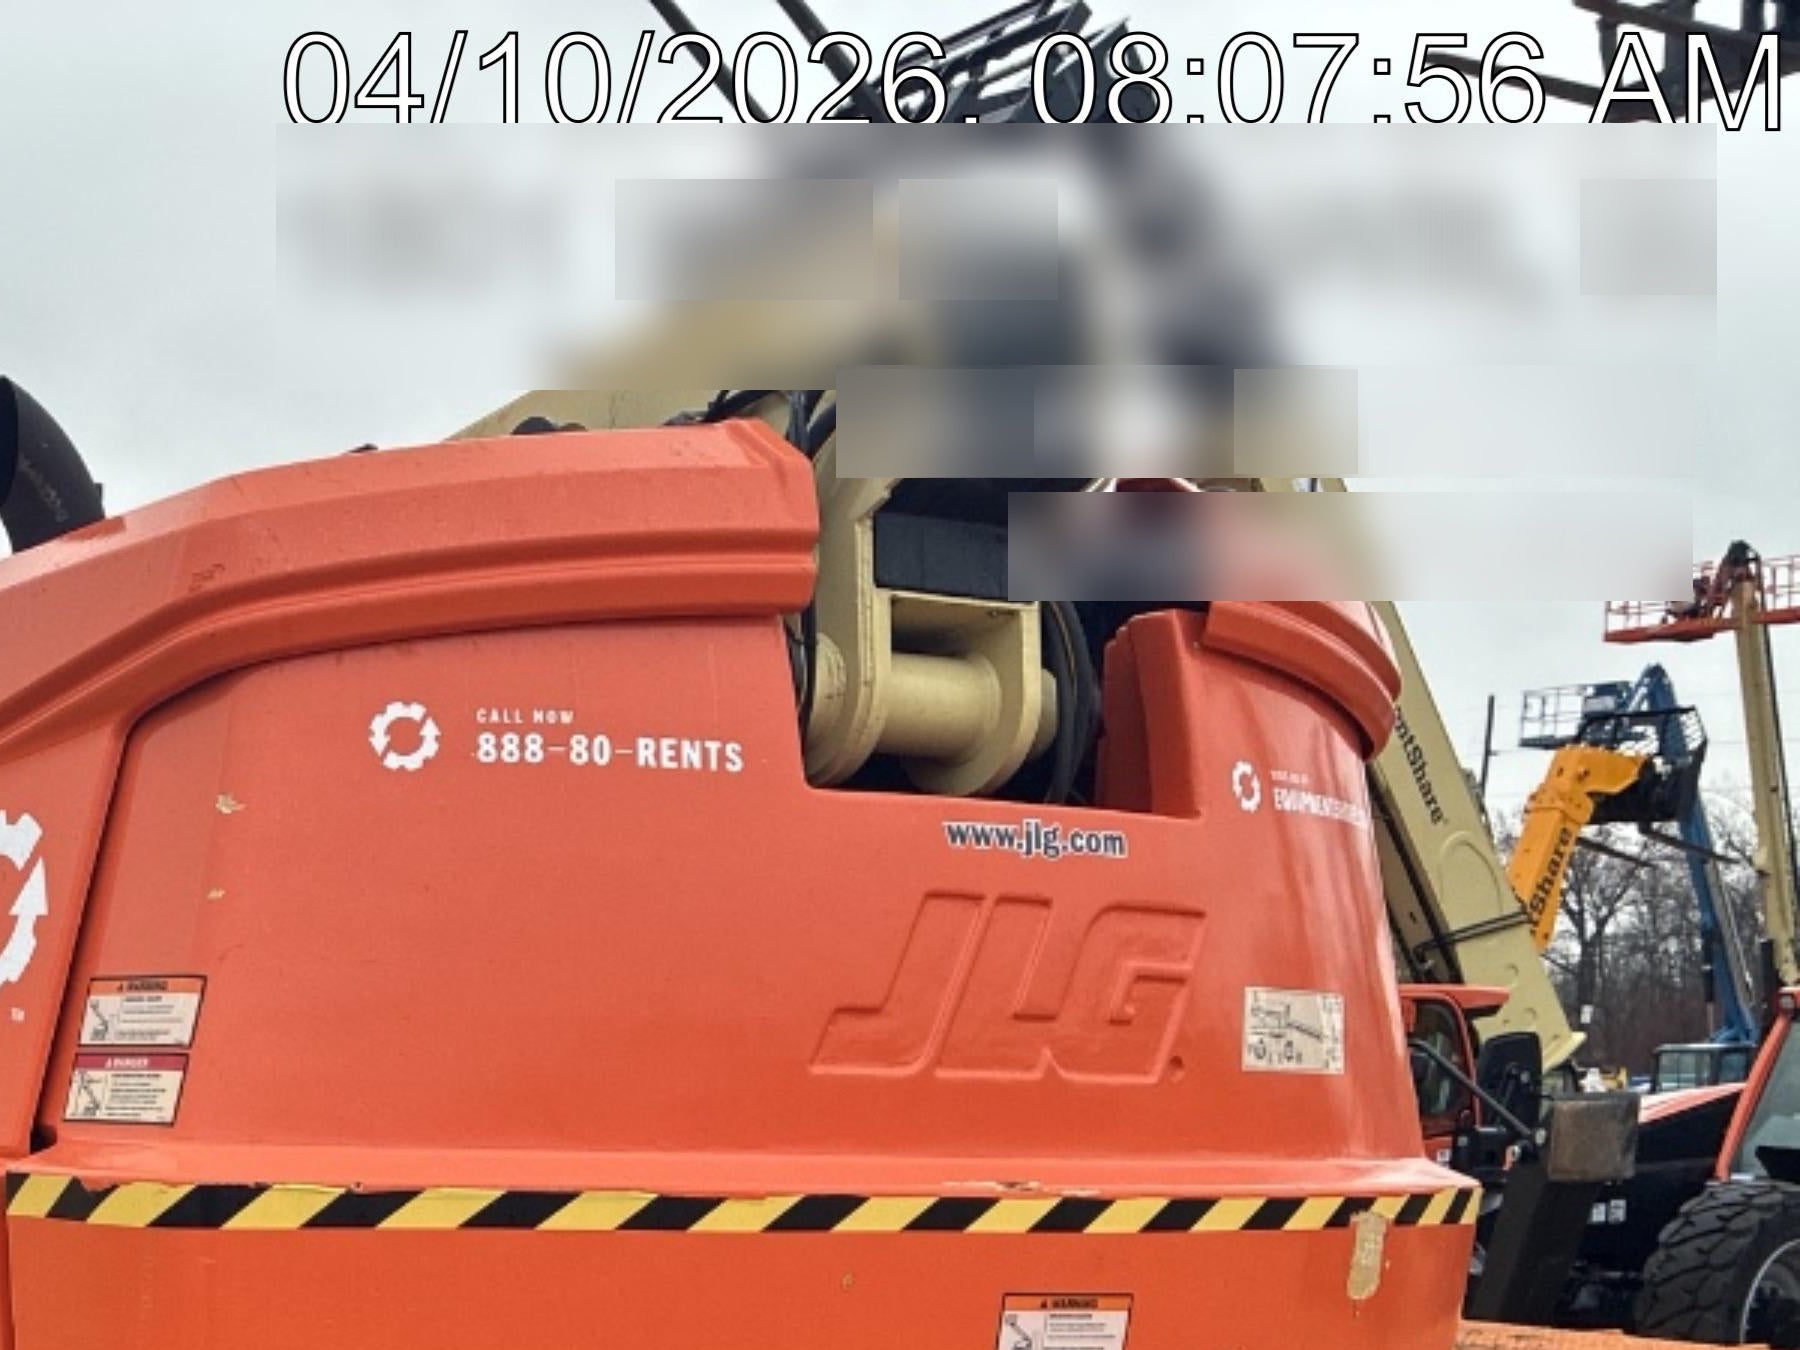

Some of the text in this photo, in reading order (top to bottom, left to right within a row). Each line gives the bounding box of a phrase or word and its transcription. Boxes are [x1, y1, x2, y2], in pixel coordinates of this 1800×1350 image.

[476, 708, 524, 724] CALL
[475, 732, 744, 773] 888-80-RENTS
[942, 818, 1128, 861] www.jlg.com
[809, 889, 1205, 1085] JLG
